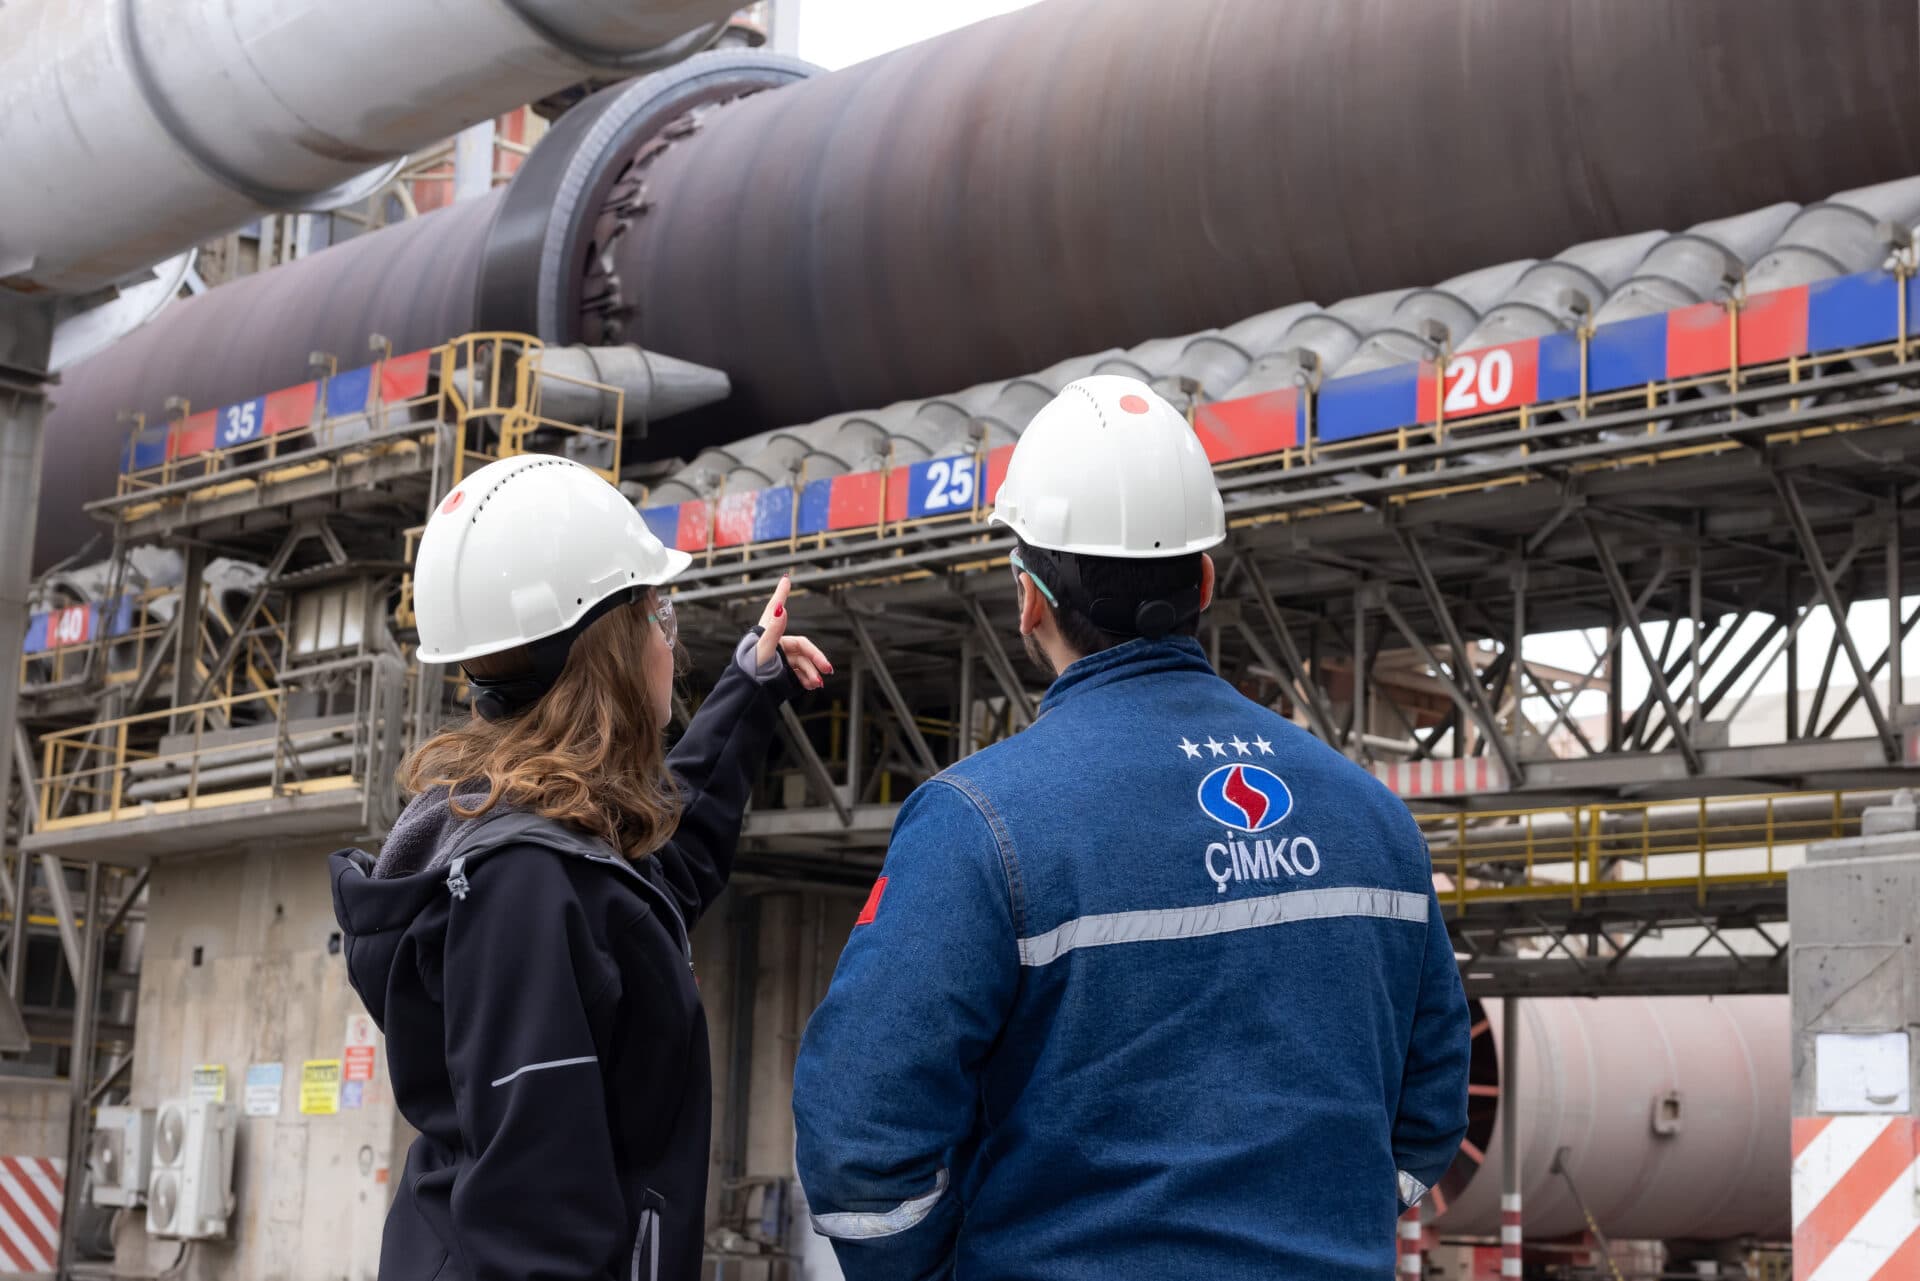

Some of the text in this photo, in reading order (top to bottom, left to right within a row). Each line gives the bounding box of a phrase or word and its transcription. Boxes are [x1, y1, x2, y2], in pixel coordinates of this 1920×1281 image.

[1444, 349, 1513, 412] 20
[224, 401, 257, 442] 35
[924, 457, 974, 509] 25
[54, 607, 83, 641] 40
[1205, 831, 1321, 893] ÇİMKO
